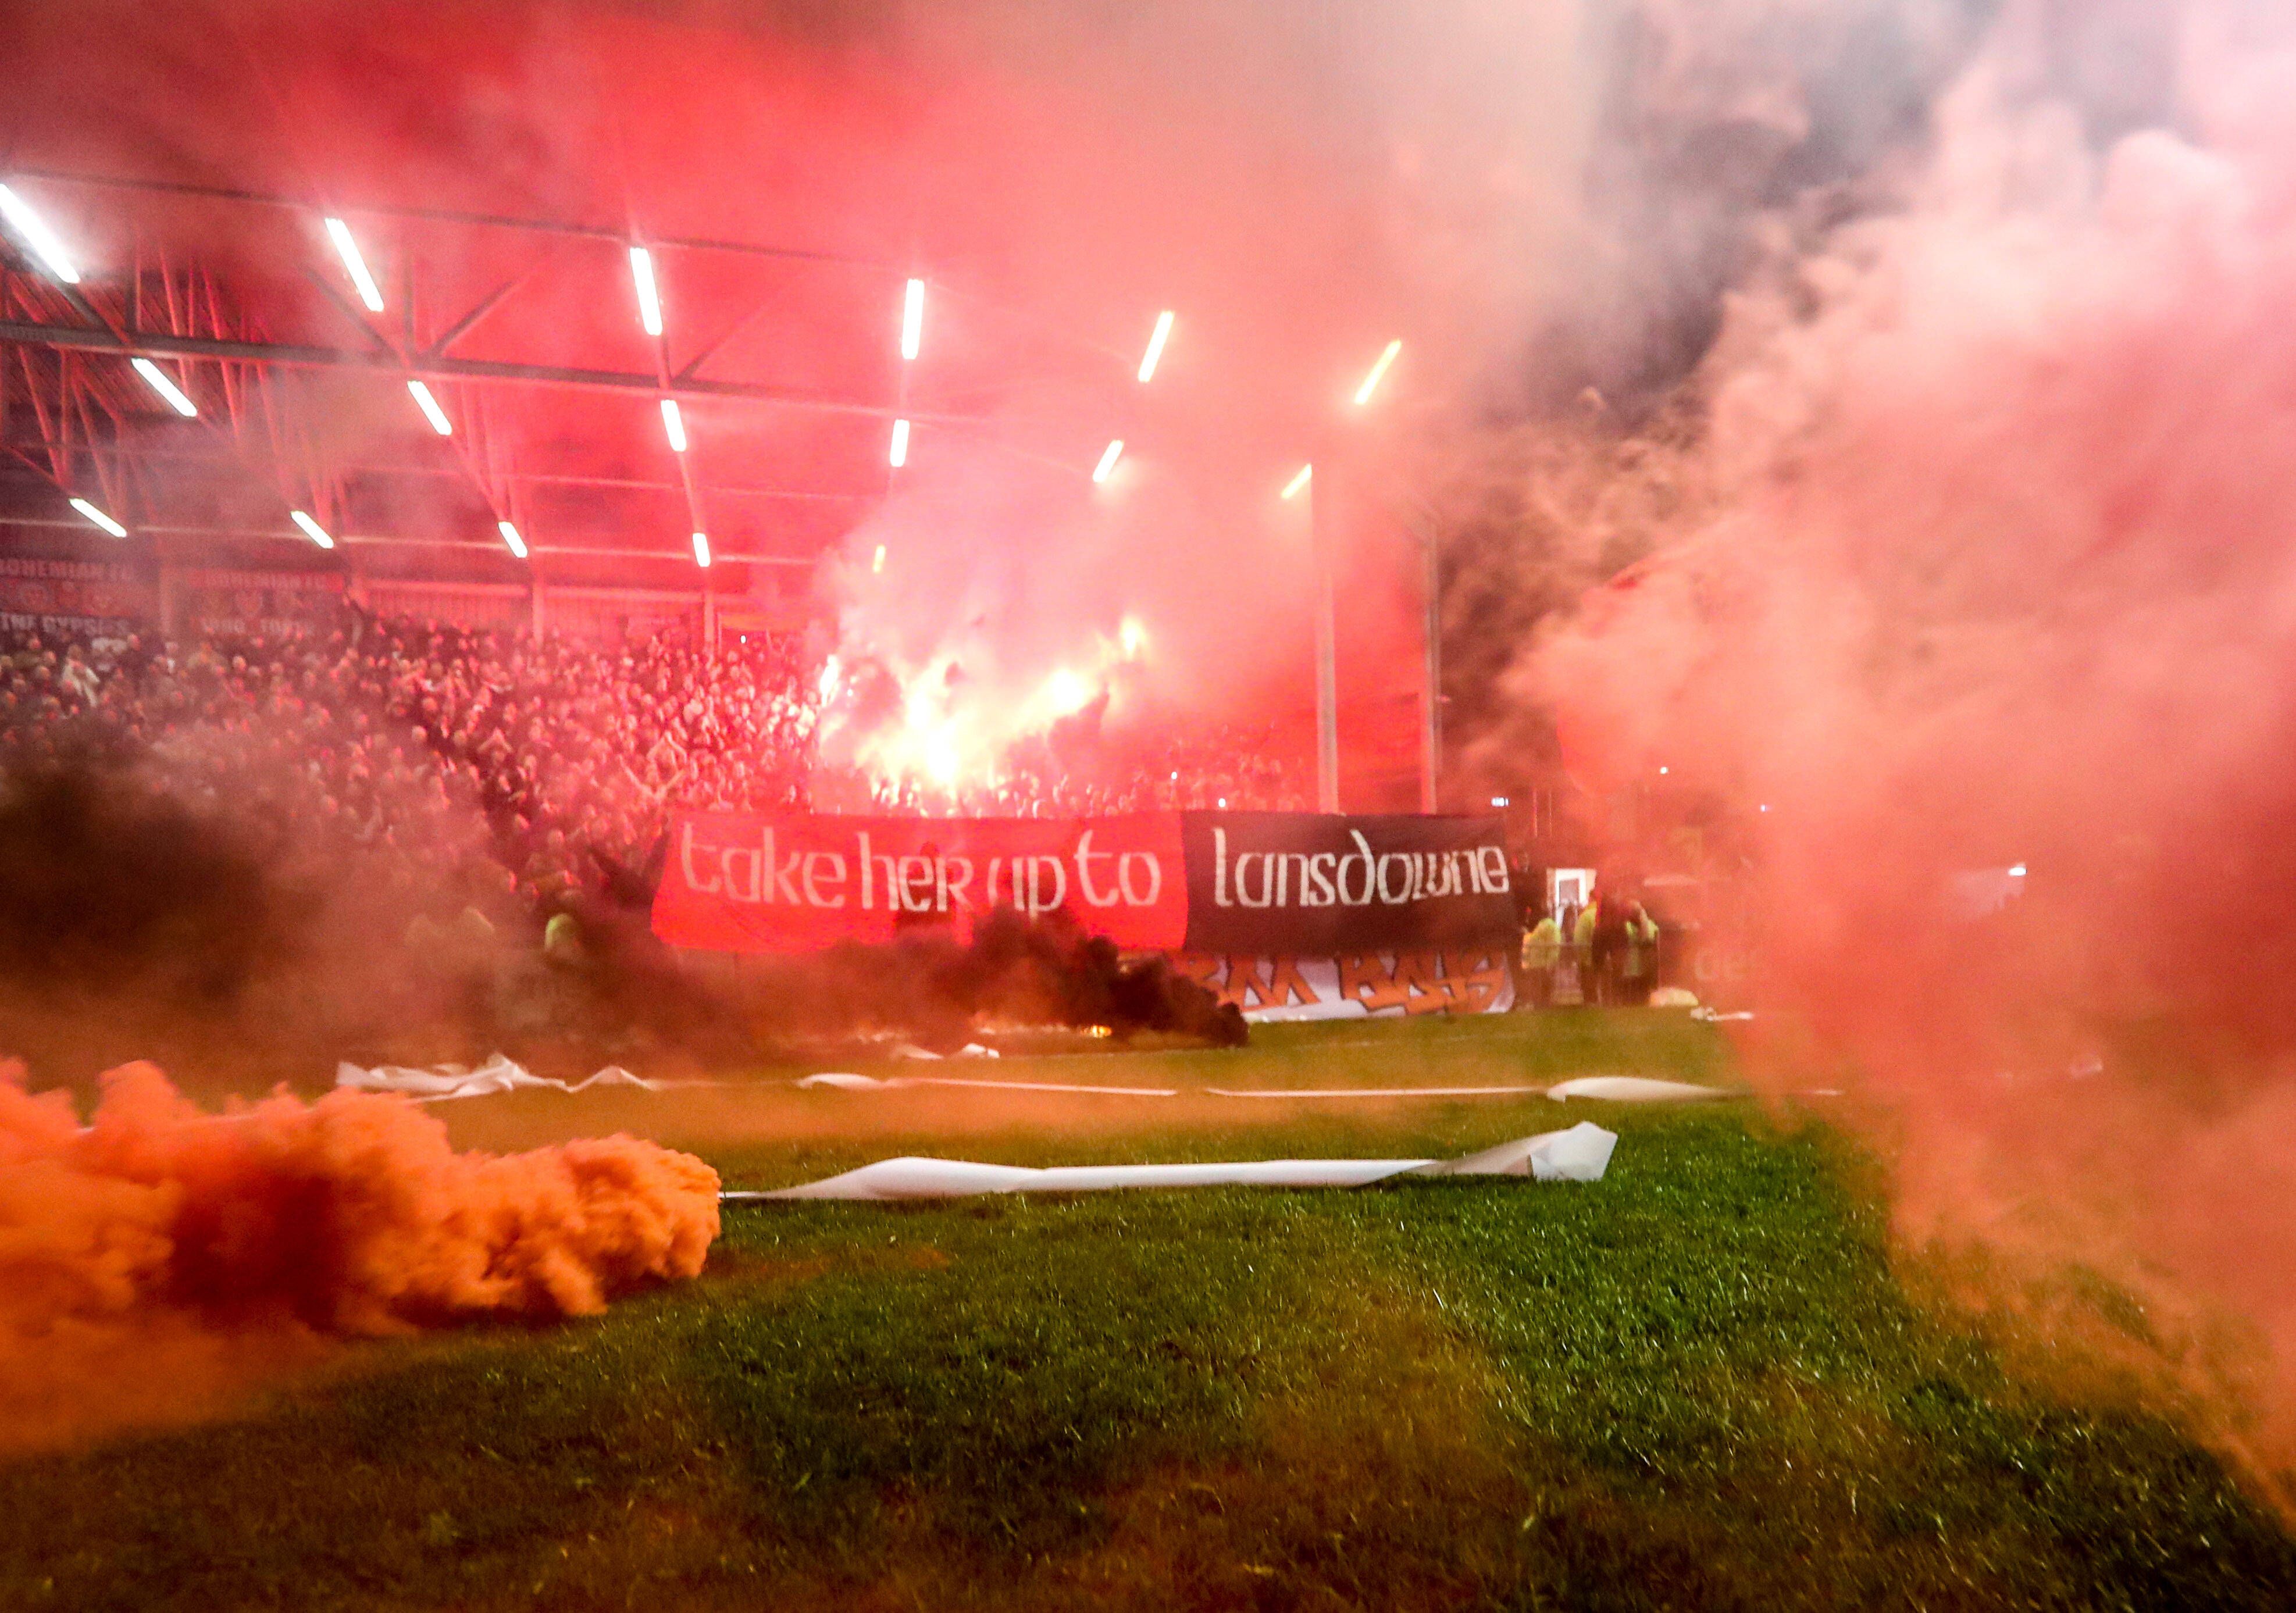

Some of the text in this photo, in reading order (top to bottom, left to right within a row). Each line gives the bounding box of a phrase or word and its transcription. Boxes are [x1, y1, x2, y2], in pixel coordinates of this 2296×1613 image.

[681, 821, 847, 907] take
[986, 855, 1067, 925] up
[1074, 829, 1161, 907] to
[1213, 827, 1510, 908] lansdowne
